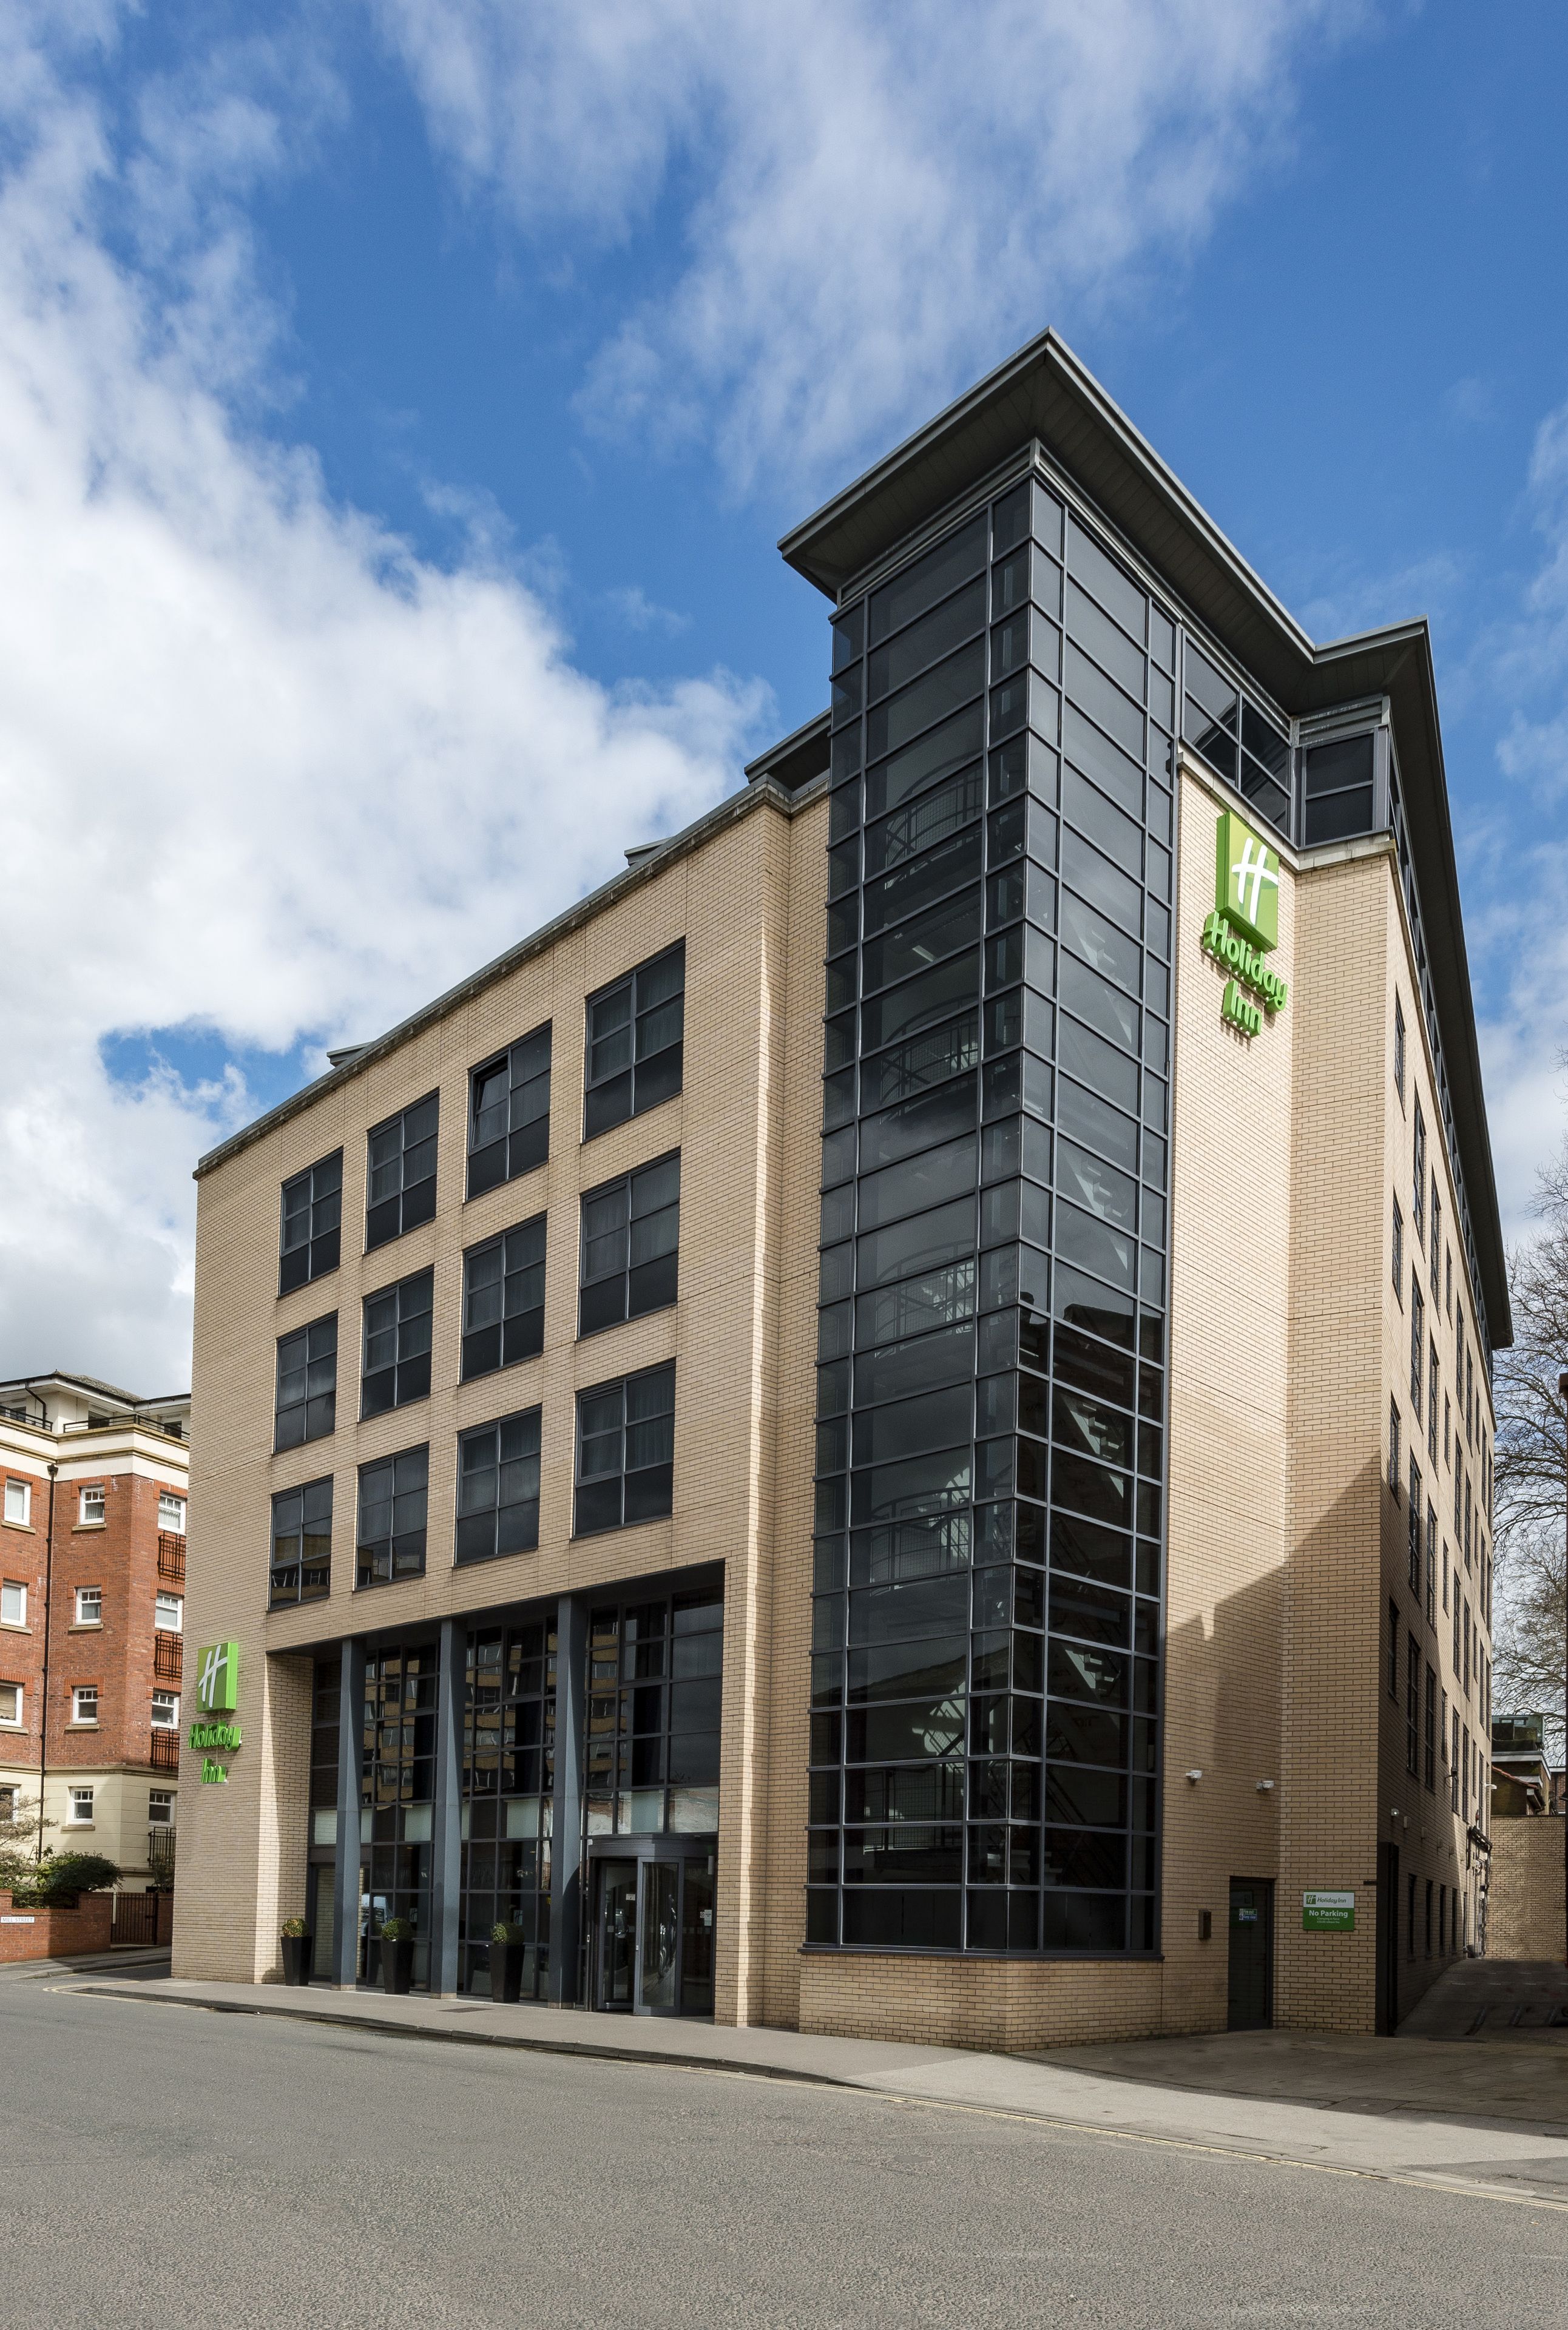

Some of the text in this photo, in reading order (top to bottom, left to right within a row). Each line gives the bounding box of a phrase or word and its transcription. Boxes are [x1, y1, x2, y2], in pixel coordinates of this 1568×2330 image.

[1203, 911, 1288, 1012] Holiday
[1223, 979, 1262, 1038] Inn
[189, 1721, 241, 1751] Holiday
[201, 1758, 226, 1783] Inn
